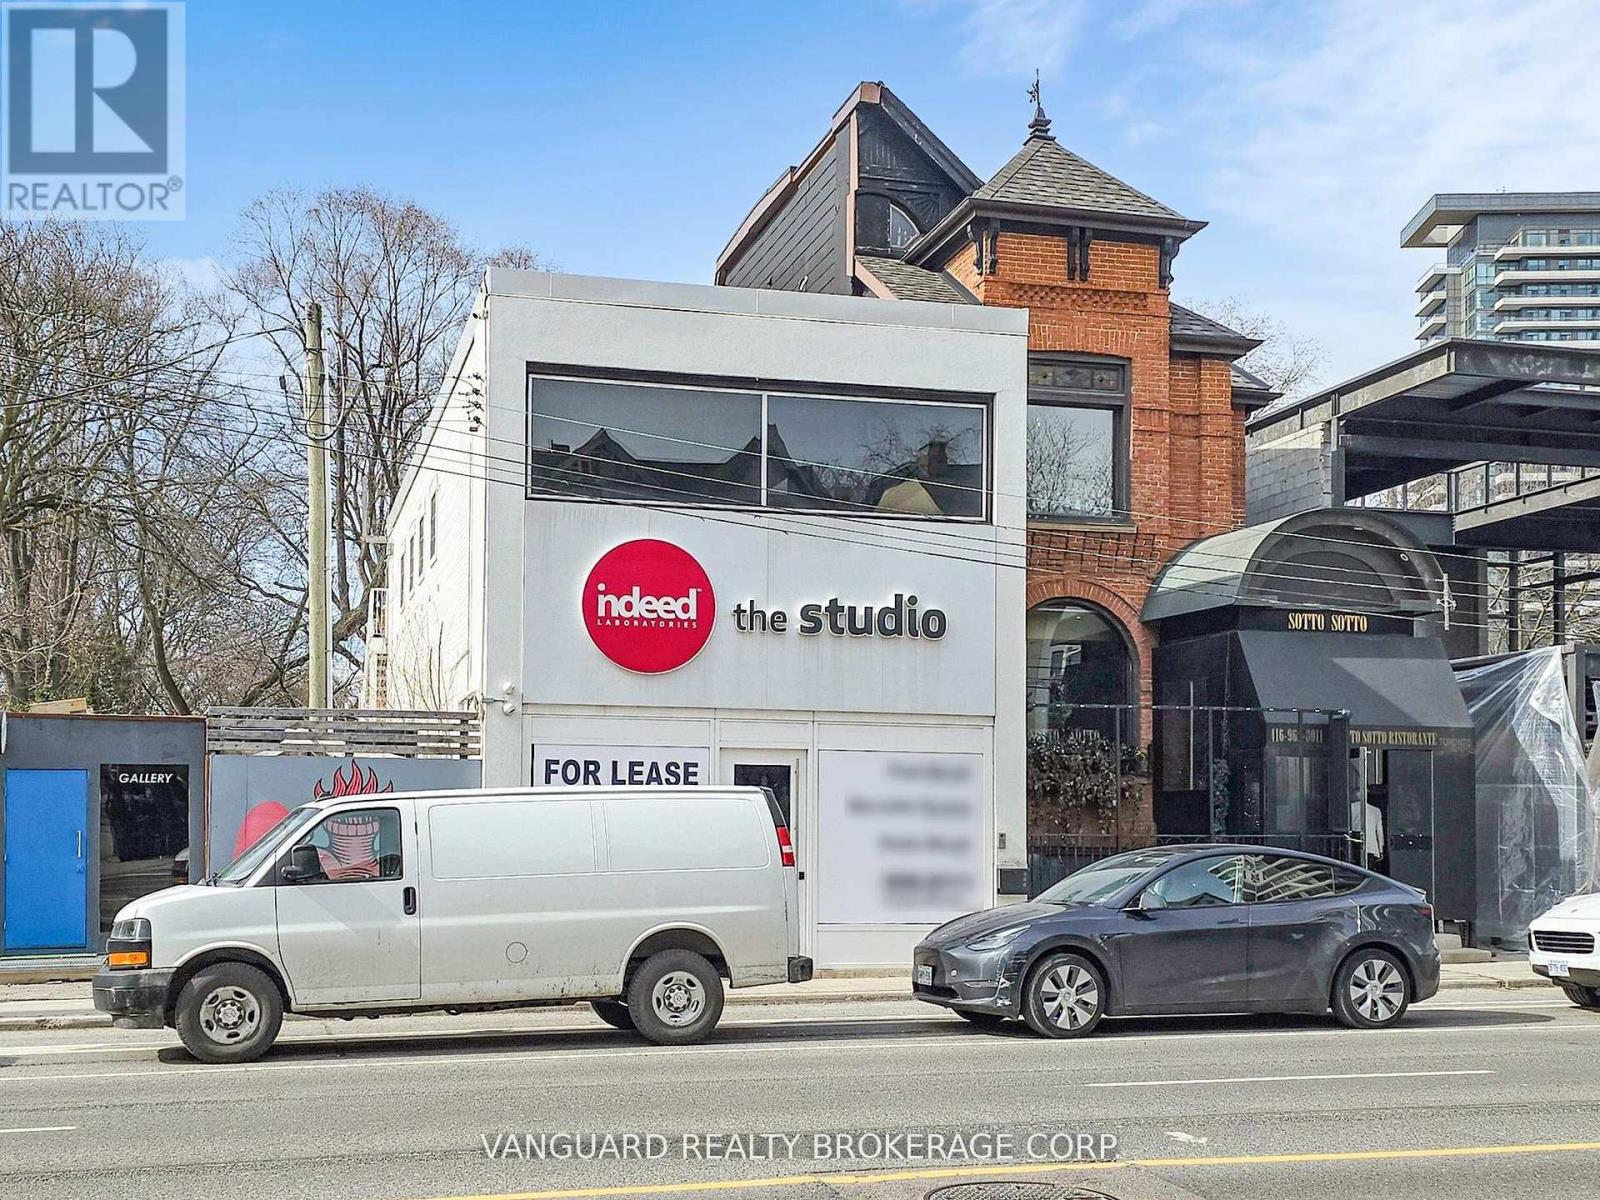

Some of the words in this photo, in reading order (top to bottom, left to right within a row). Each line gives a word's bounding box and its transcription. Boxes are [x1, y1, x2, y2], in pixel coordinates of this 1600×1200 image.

[597, 583, 698, 620] indeed
[597, 619, 698, 629] LABORATORIES
[732, 600, 788, 633] the
[799, 594, 947, 639] studio
[1288, 612, 1325, 631] SOTTO
[1331, 614, 1368, 632] SOTTO
[1362, 730, 1387, 745] SOTTO
[1388, 731, 1438, 747] RISTORANTE
[118, 773, 174, 784] GALLERY
[544, 759, 601, 786] FOR
[611, 760, 699, 786] LEASE
